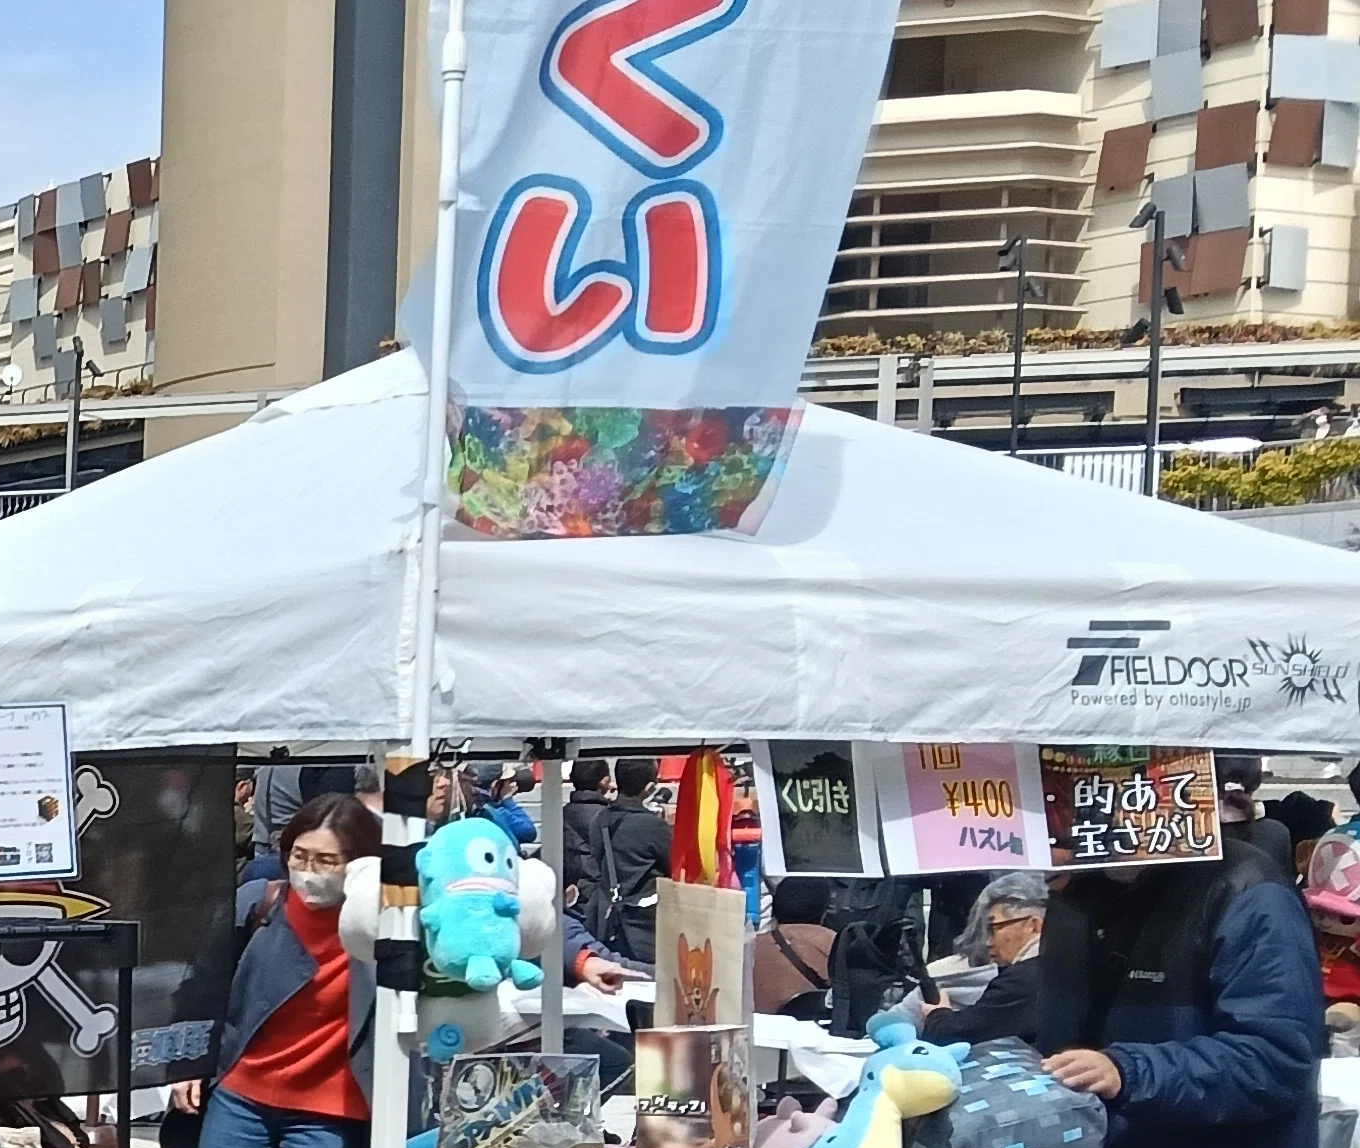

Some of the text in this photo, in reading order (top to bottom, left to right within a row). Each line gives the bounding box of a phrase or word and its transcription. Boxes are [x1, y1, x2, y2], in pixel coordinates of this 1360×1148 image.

[1111, 655, 1250, 688] FIELDOOR
[1070, 689, 1137, 706] Powered
[1144, 688, 1163, 710] by
[781, 777, 850, 814] くじ引き
